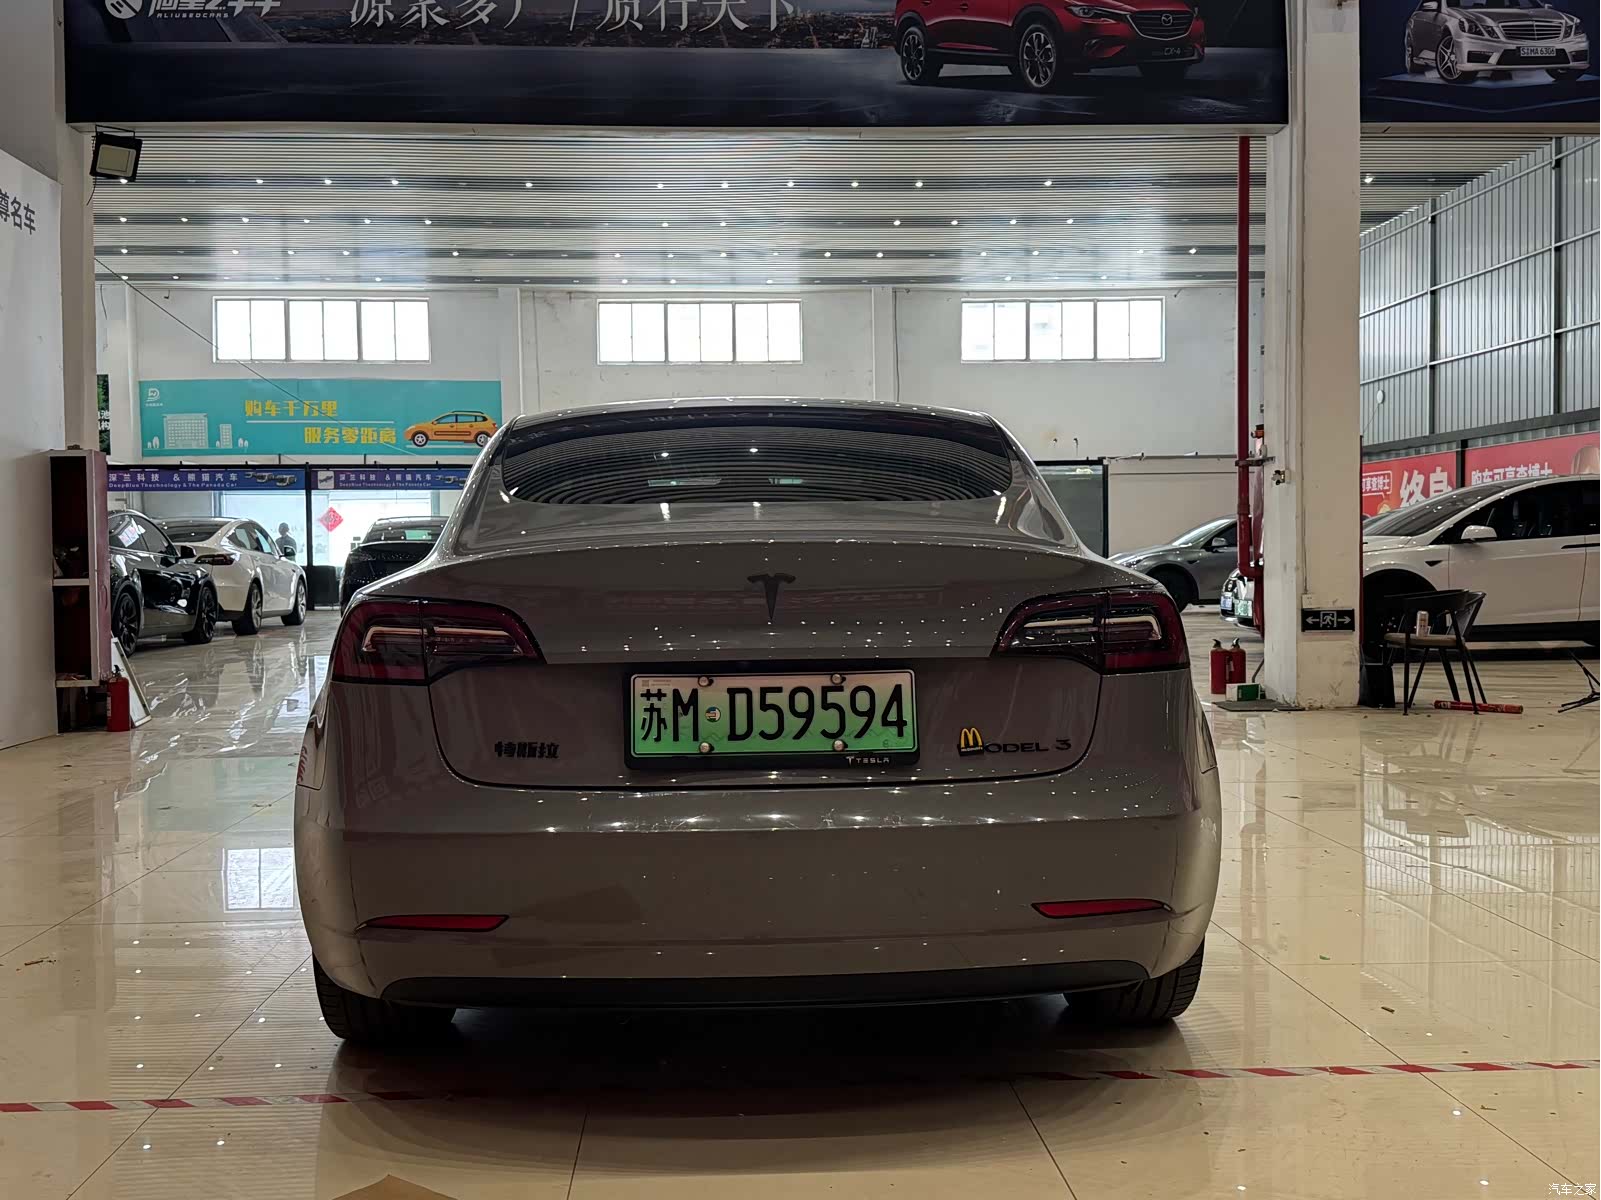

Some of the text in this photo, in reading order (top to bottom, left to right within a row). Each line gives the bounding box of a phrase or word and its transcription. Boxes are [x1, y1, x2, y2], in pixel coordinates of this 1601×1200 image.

[1163, 47, 1181, 56] CX-4
[245, 400, 338, 417] 购车千万里
[304, 427, 396, 444] 服务零距离
[108, 473, 238, 482] 深兰科技 & 熊猫汽车
[726, 684, 908, 742] D59594
[494, 741, 560, 759] 特斯拉
[1055, 739, 1072, 751] 3
